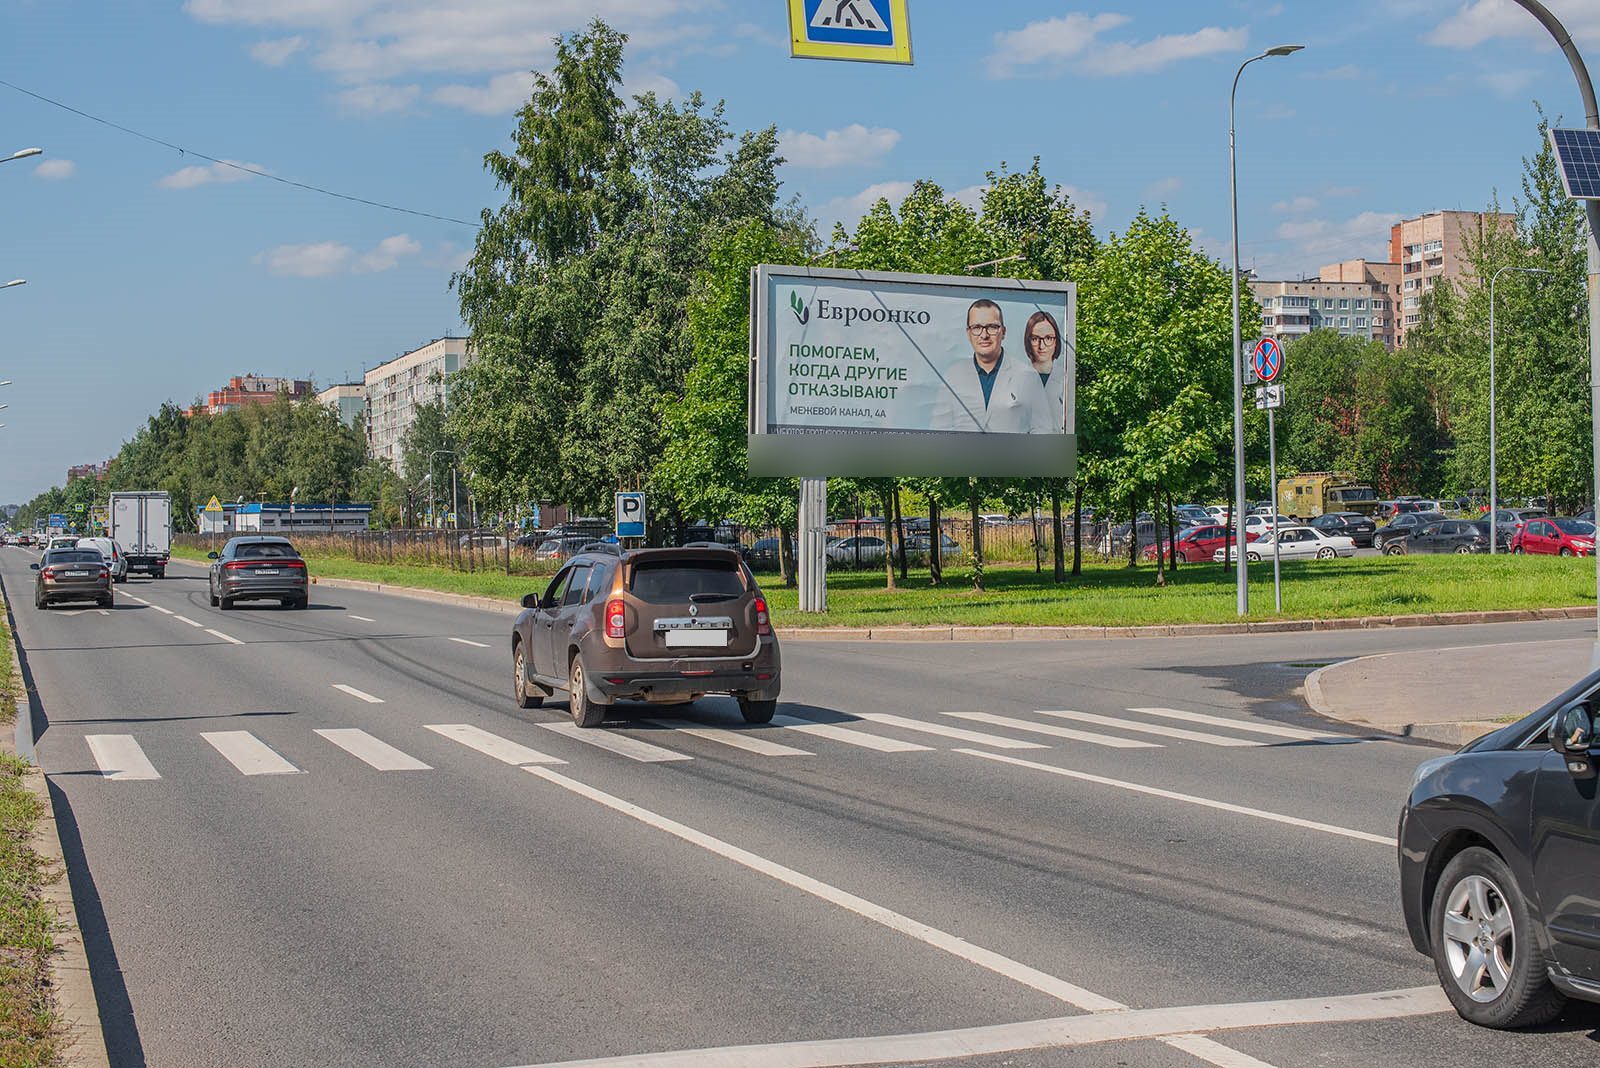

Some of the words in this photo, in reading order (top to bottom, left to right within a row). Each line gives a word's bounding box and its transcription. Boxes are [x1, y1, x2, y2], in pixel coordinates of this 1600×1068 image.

[816, 299, 931, 327] Евроонко
[789, 344, 880, 363] ПОМОГАЕМ,
[789, 364, 840, 380] КОГДА
[844, 365, 908, 381] ДРУГИЕ
[788, 383, 898, 399] ОТКАЗЫВАЮТ
[790, 406, 837, 416] МЕЖЕВОЙ
[839, 409, 873, 418] КАНАЛ,
